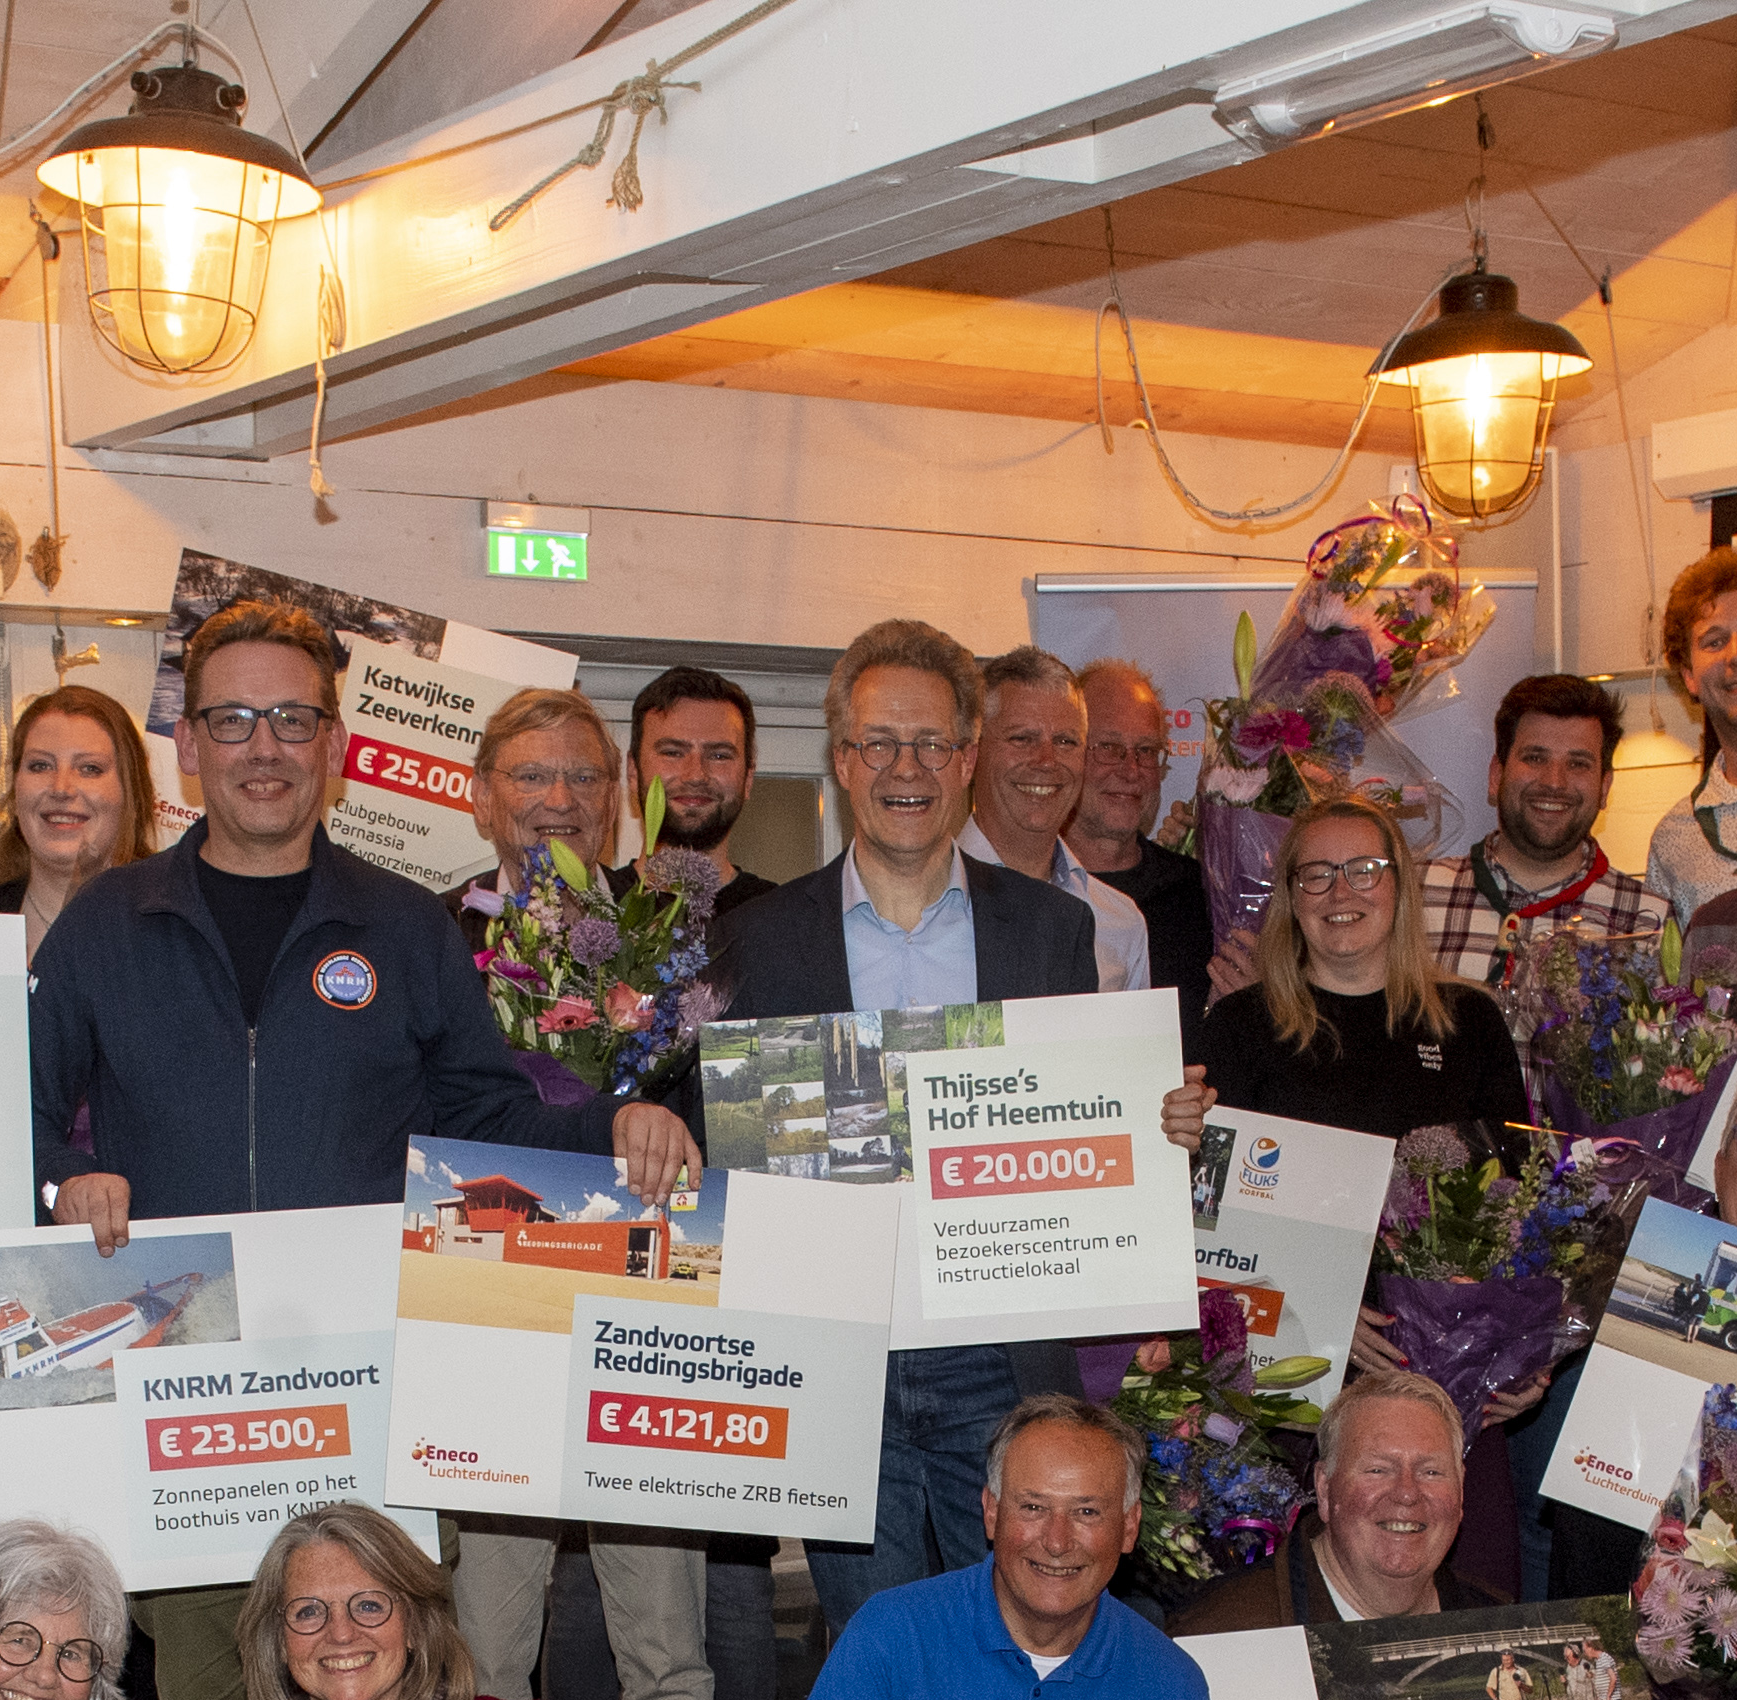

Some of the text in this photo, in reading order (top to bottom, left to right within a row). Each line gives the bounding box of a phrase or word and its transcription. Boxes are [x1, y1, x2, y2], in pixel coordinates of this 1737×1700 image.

[364, 665, 475, 713] Katwijkse
[159, 801, 200, 821] Eneco
[334, 797, 431, 837] Clubgebouw
[330, 819, 405, 851] Parnassia
[326, 976, 365, 986] KNRM
[928, 1096, 1122, 1131] Hof Heemtuin
[972, 1147, 1117, 1185] 20.000,-
[1242, 1168, 1280, 1187] FLUKS
[1239, 1188, 1275, 1200] KORFBAL
[934, 1214, 1070, 1238] Verduurzamen
[936, 1232, 1137, 1260] bezoekerscentrum en
[938, 1256, 1081, 1284] instructielokaal
[595, 1320, 756, 1357] Zandvoortse
[143, 1364, 380, 1402] KNRM Zandvoort
[594, 1348, 804, 1389] Reddingsbrigade
[191, 1417, 337, 1456] 23.500,-
[628, 1405, 770, 1448] 4.121,80
[425, 1445, 479, 1464] Eneco
[1586, 1454, 1633, 1480] Eneco
[153, 1473, 357, 1506] Zonnepanelen op het
[429, 1464, 530, 1485] Luchterduinen
[585, 1470, 848, 1509] Twee elektrische ZRB fietsen
[155, 1505, 280, 1531] boothuis van
